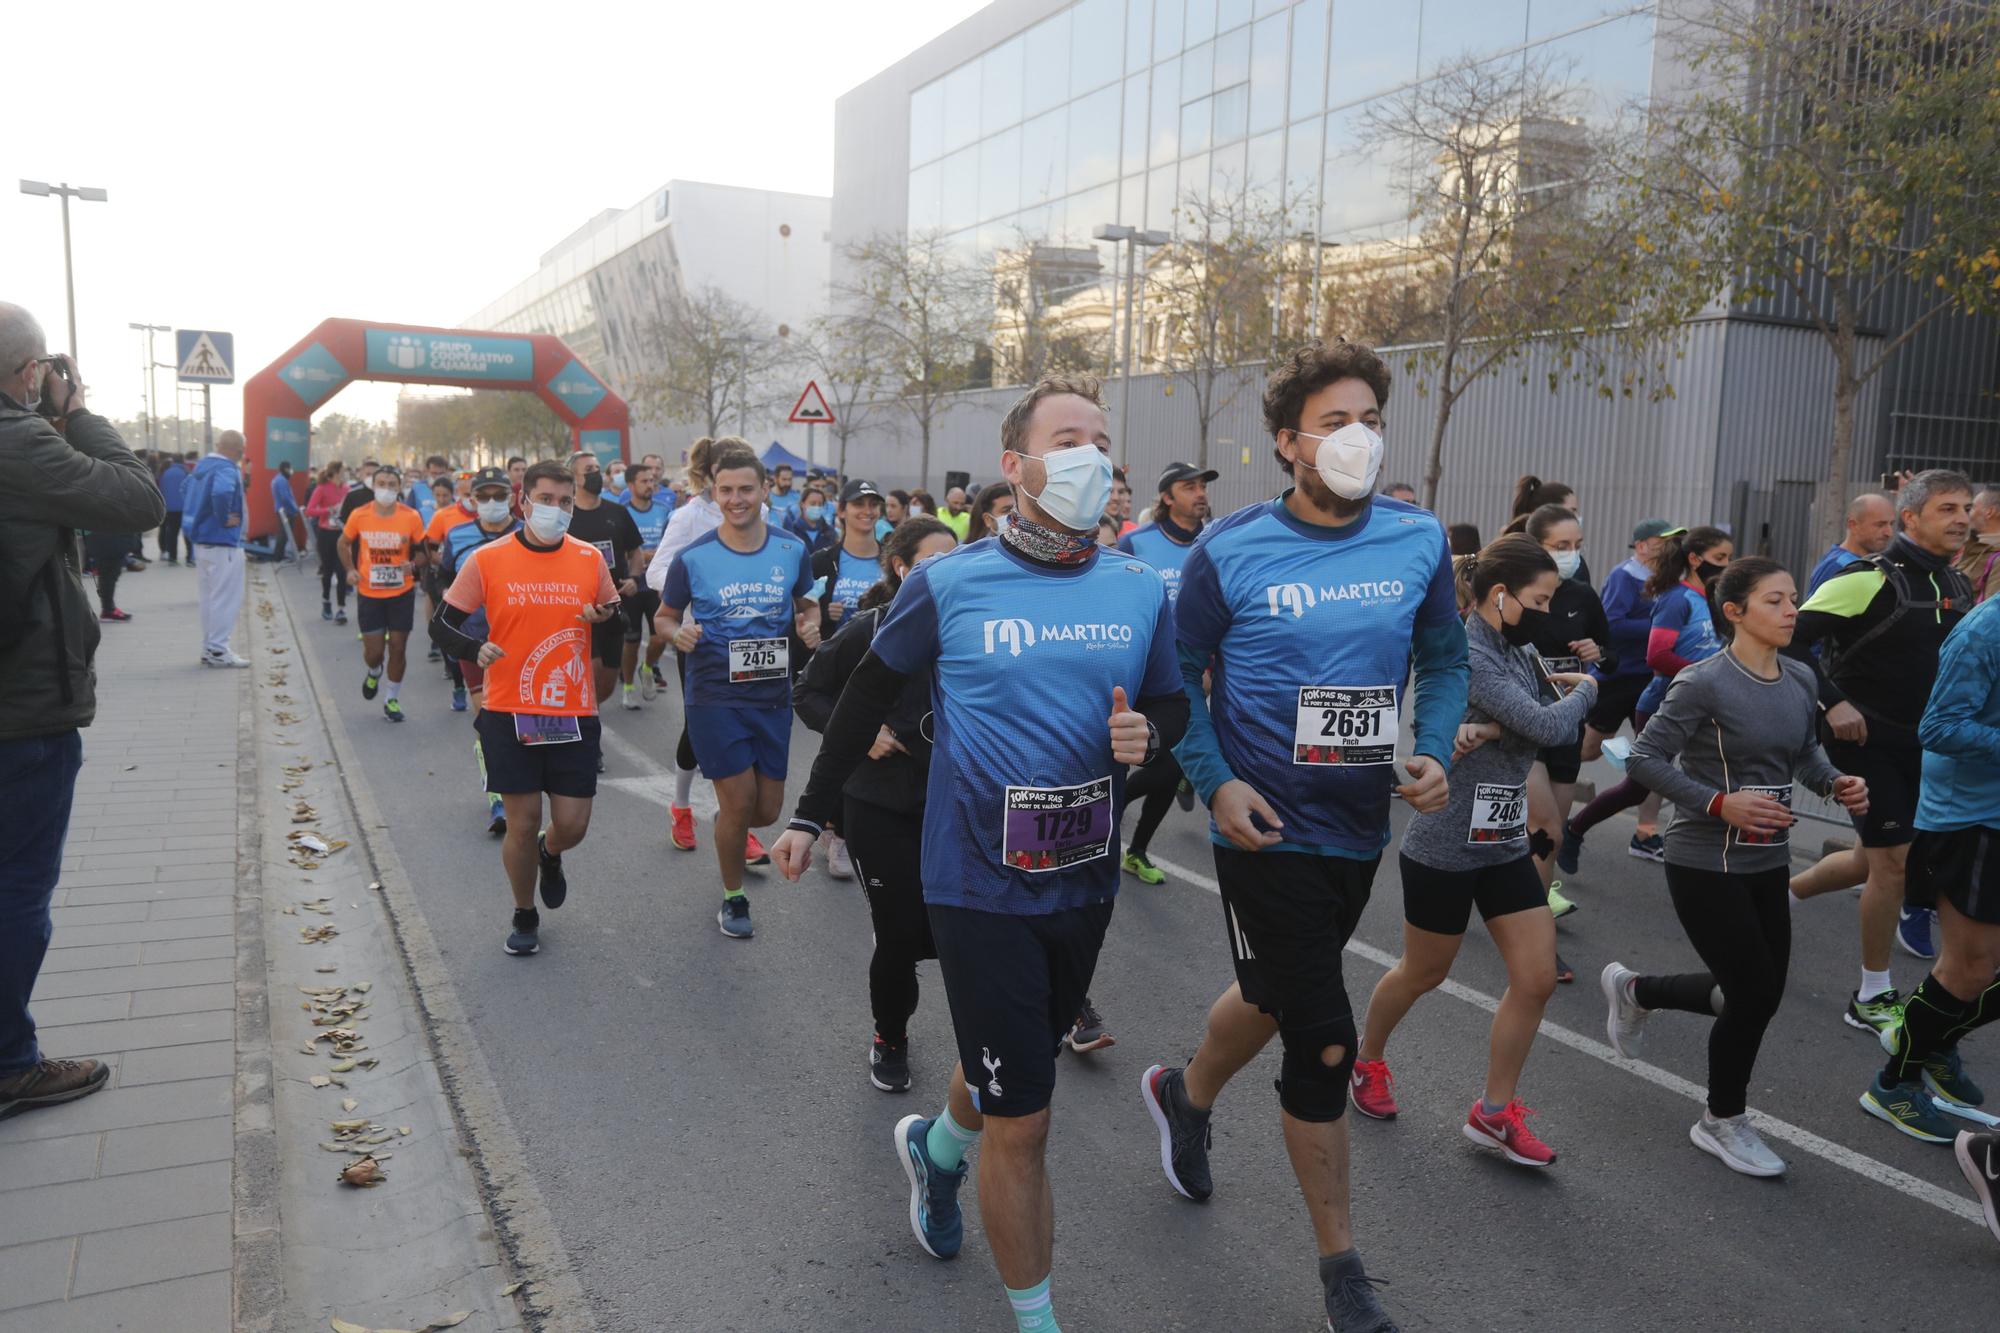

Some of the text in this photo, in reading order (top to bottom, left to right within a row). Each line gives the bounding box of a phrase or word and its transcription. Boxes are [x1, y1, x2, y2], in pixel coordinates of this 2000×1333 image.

[430, 341, 472, 352] GRUPO
[430, 350, 513, 364] COOPERATIVO
[430, 361, 487, 371] CAJAMAR
[507, 582, 580, 593] VNIVERSITAT
[719, 582, 784, 600] 10K PAS RAS
[1320, 580, 1404, 602] MARTICO
[730, 598, 747, 606] PORT
[1041, 623, 1132, 642] MARTICO
[742, 651, 776, 667] 2475
[1303, 690, 1320, 701] 10K
[1337, 692, 1352, 702] RAS
[1320, 709, 1381, 737] 2631
[1010, 790, 1063, 803] 10K PAS RAS
[1487, 800, 1523, 822] 2482
[1033, 807, 1093, 841] 1729
